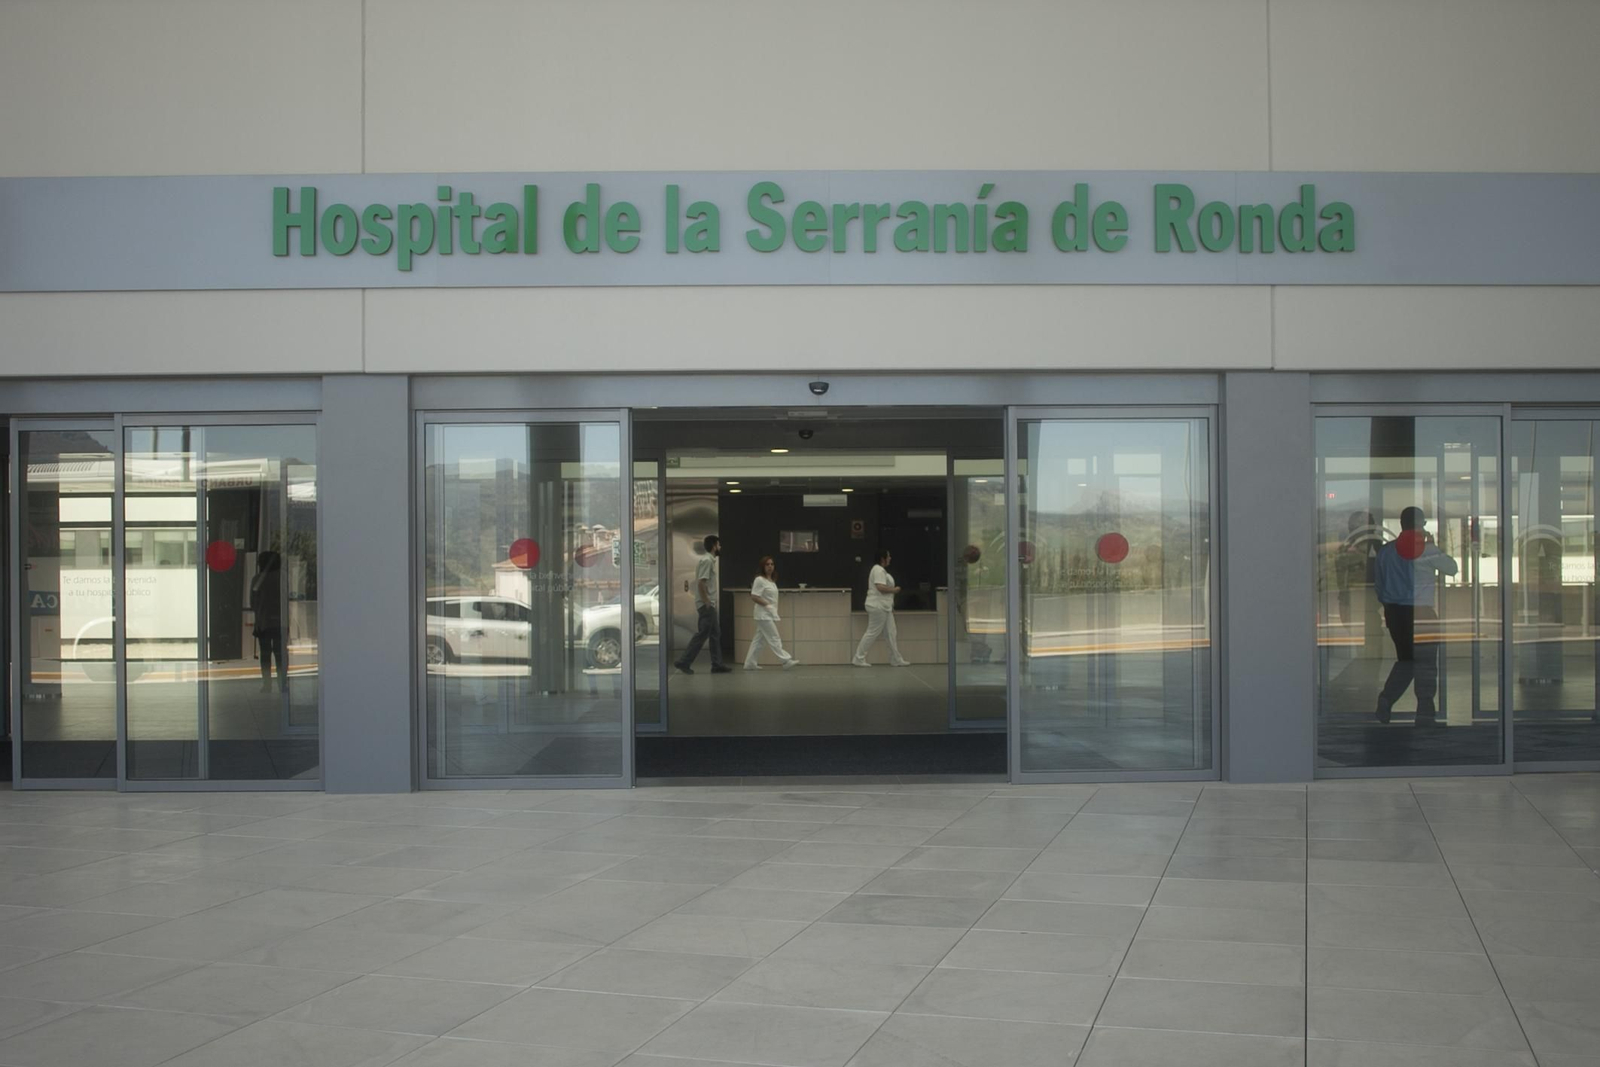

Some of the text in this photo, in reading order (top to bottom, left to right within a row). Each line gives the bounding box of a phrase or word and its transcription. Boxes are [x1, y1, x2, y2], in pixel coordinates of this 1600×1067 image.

[271, 180, 1357, 271] Hospital de la Serranía de Ronda
[62, 575, 72, 584] Te
[73, 575, 102, 584] damos
